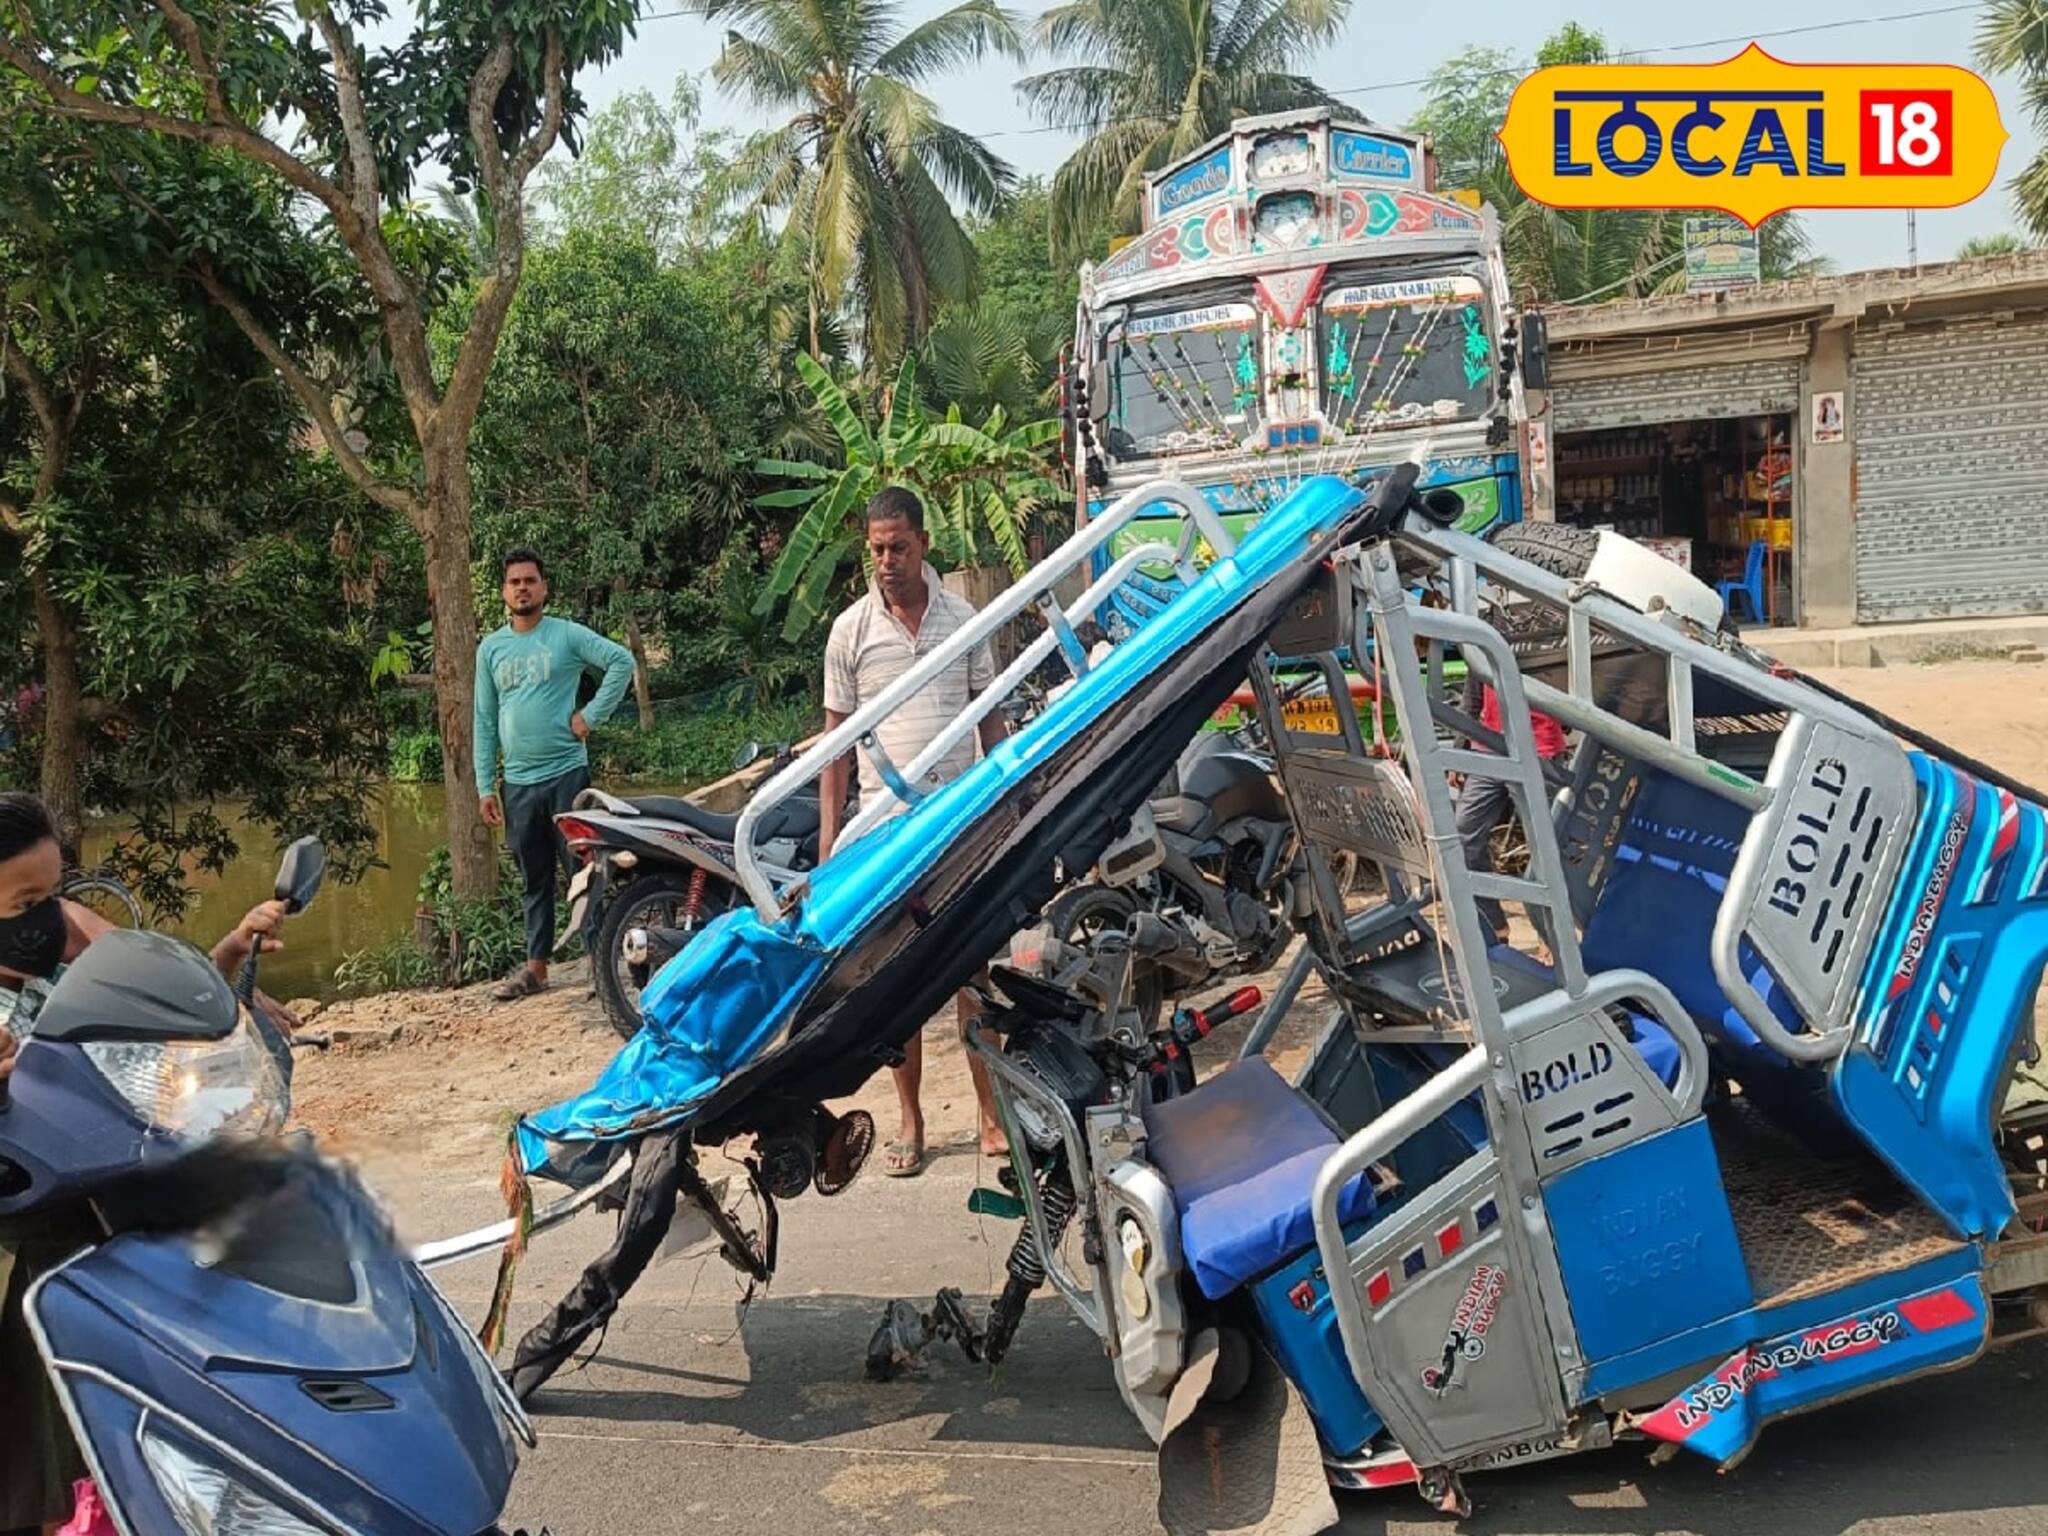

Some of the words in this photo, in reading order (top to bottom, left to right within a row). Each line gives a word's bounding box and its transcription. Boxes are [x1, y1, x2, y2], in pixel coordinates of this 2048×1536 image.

[1161, 162, 1228, 207] Goods
[1337, 138, 1407, 173] Carrier
[1768, 757, 1847, 918] BOLD
[1521, 1041, 1613, 1104] BOLD
[1598, 1230, 1703, 1297] BUGGY
[1454, 1265, 1490, 1328] INDIAN
